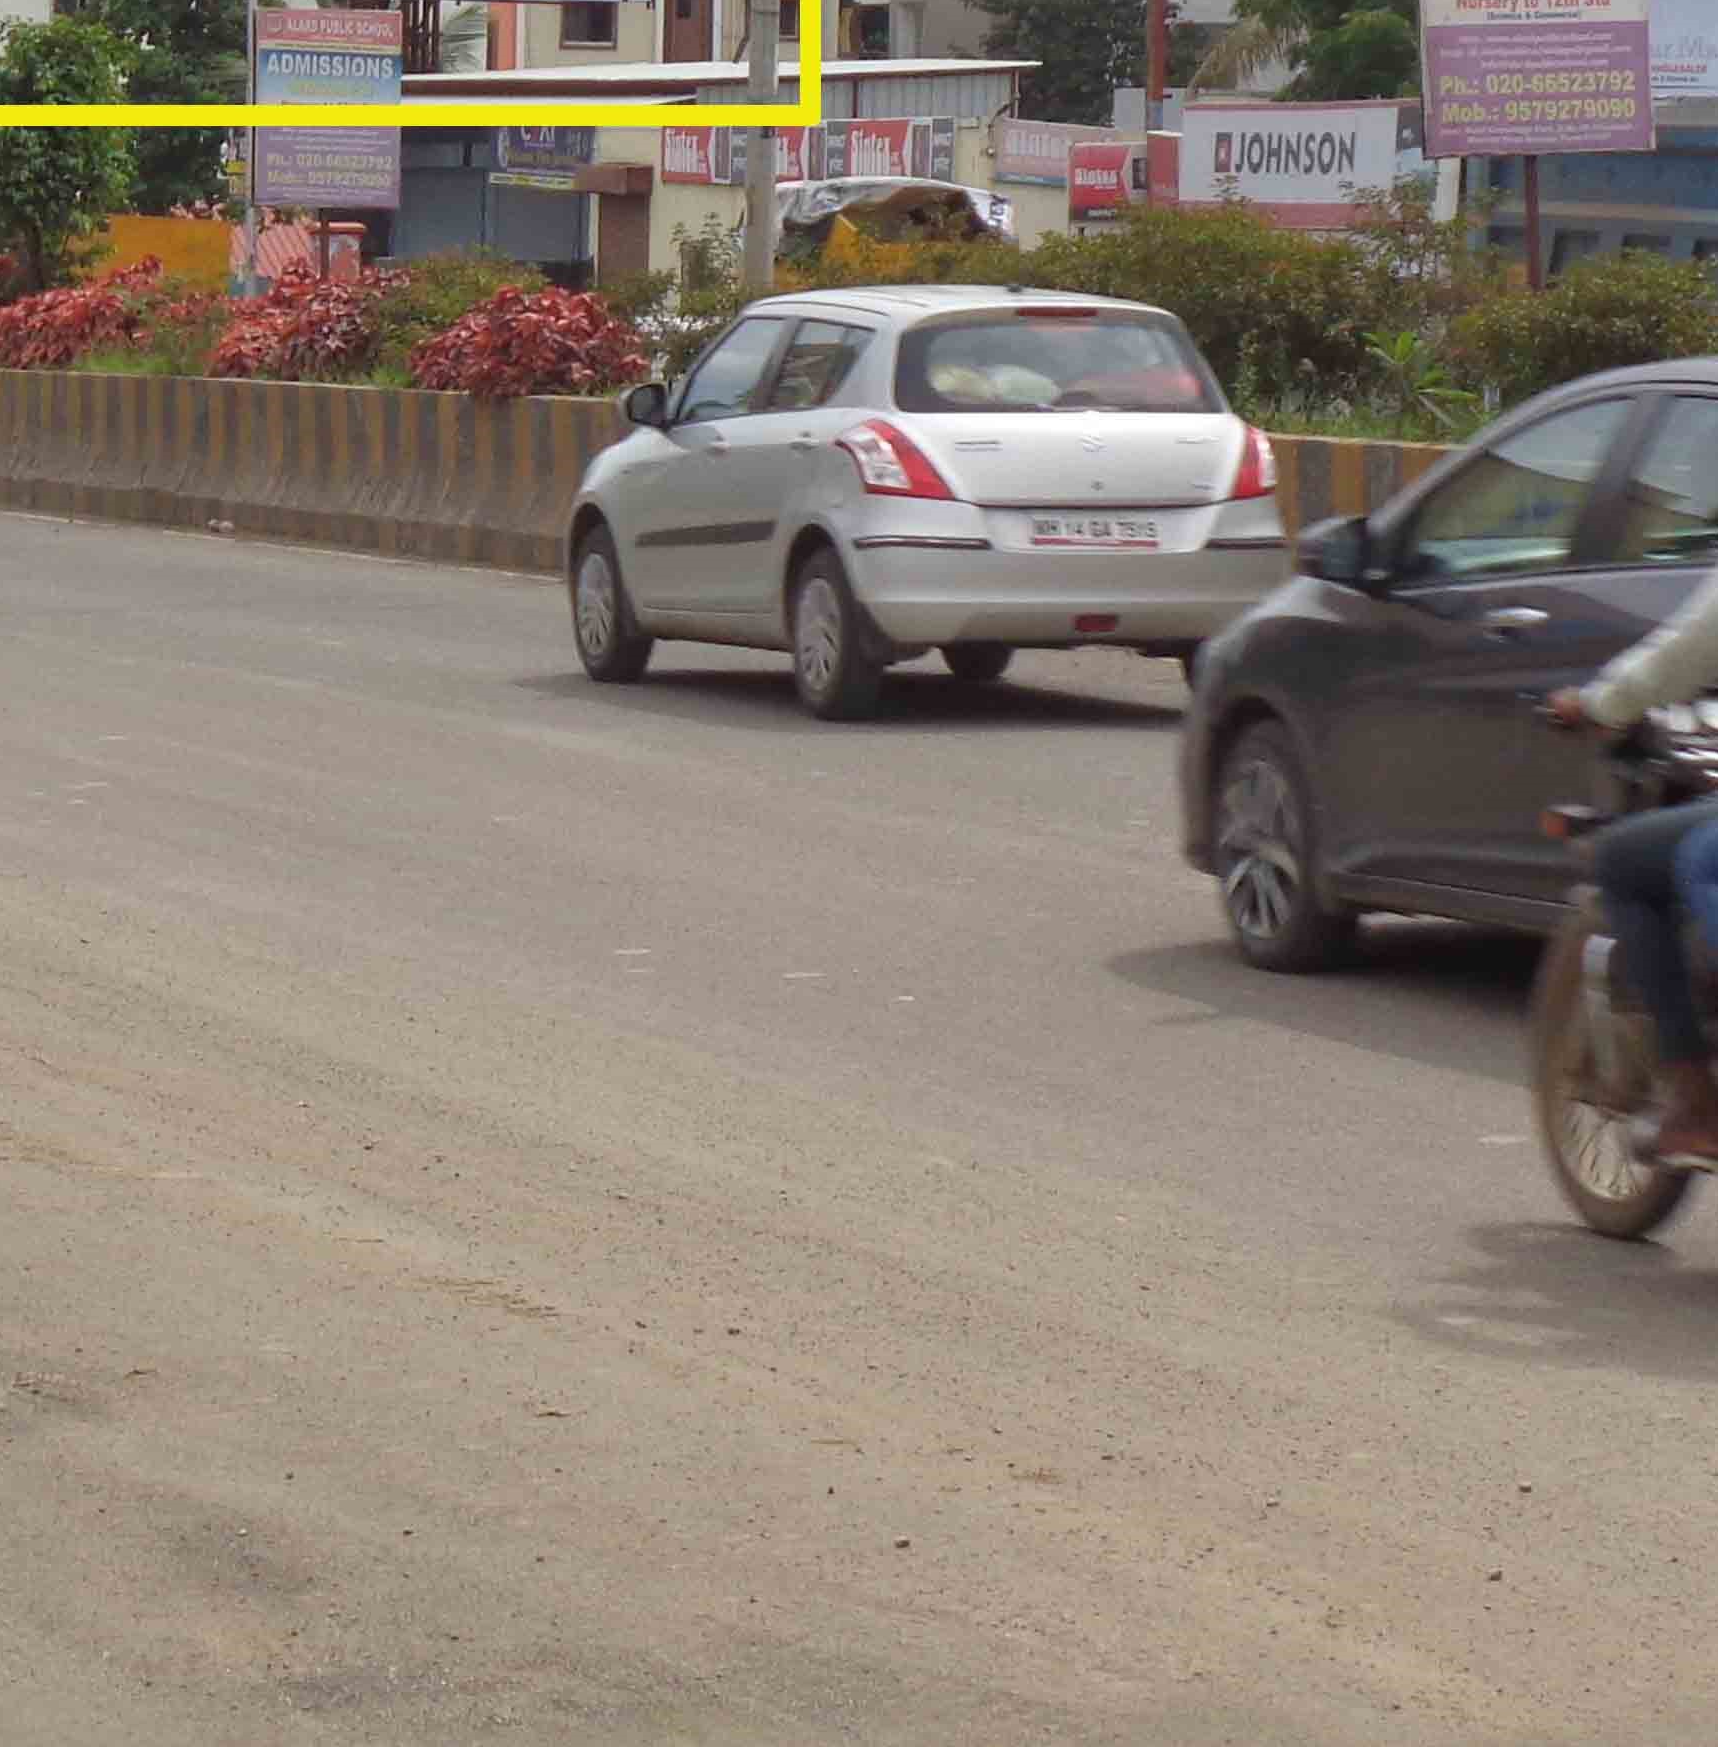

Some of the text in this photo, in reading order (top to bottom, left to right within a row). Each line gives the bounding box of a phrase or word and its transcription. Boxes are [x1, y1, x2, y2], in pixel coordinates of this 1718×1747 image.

[267, 52, 395, 79] ADMISSIONS
[1440, 76, 1481, 96] Ph.:
[1486, 71, 1636, 93] 020-66523792
[850, 128, 891, 176] Sintex
[1235, 131, 1356, 174] JOHNSON
